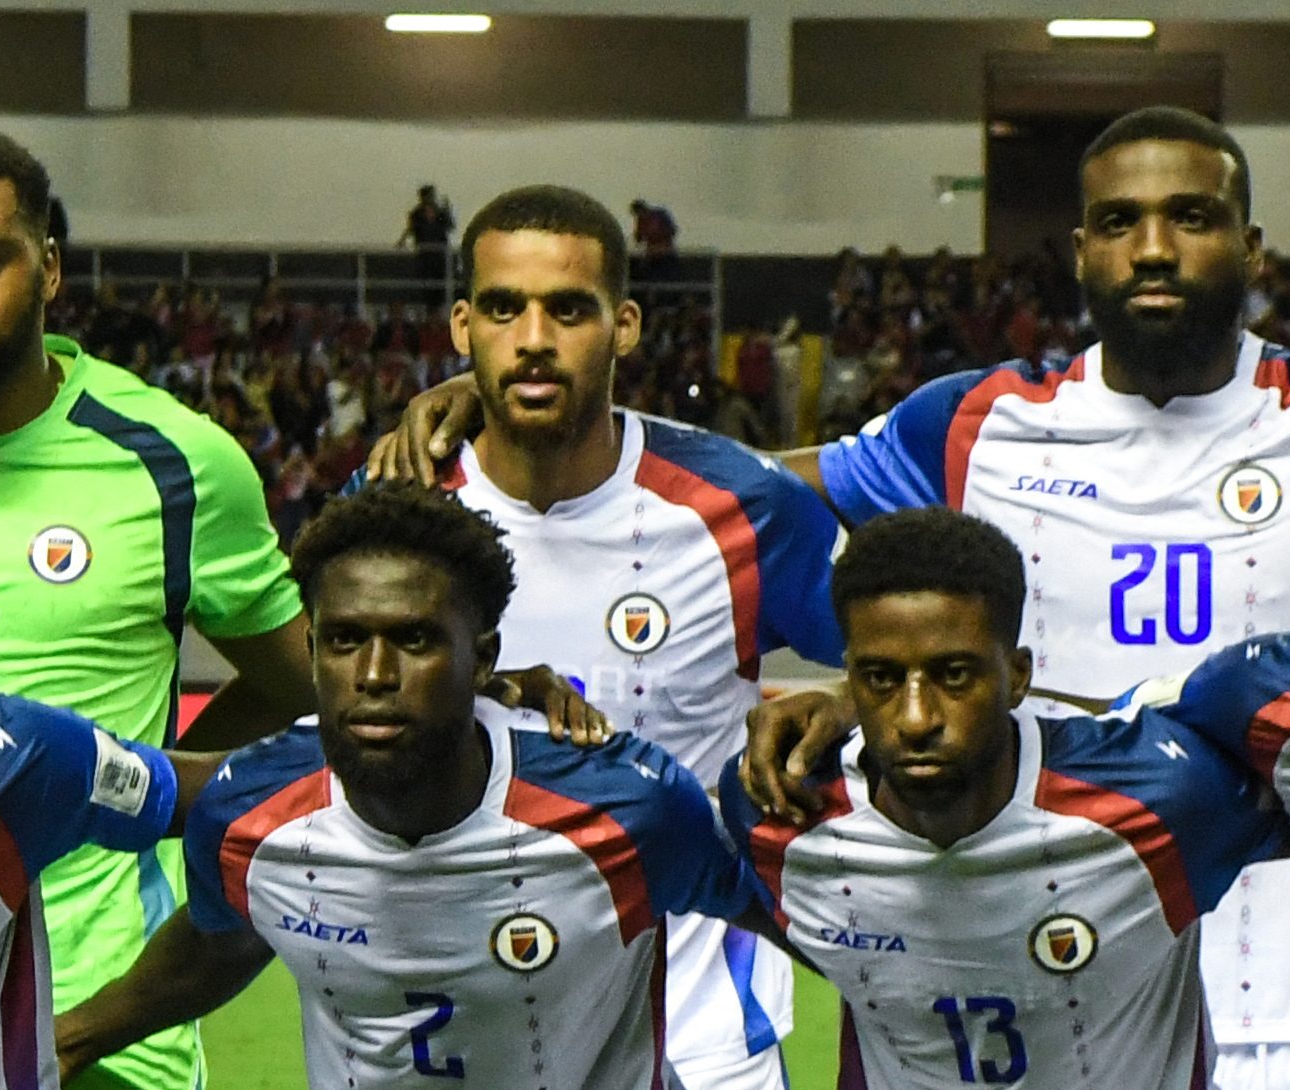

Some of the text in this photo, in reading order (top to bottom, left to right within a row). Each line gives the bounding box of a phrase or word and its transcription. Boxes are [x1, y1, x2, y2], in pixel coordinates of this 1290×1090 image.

[1009, 475, 1099, 499] SAETA
[1110, 543, 1212, 645] 20
[276, 914, 369, 946] SAETA
[819, 927, 907, 952] SAETA
[404, 991, 465, 1079] 2
[932, 996, 1029, 1083] 13
